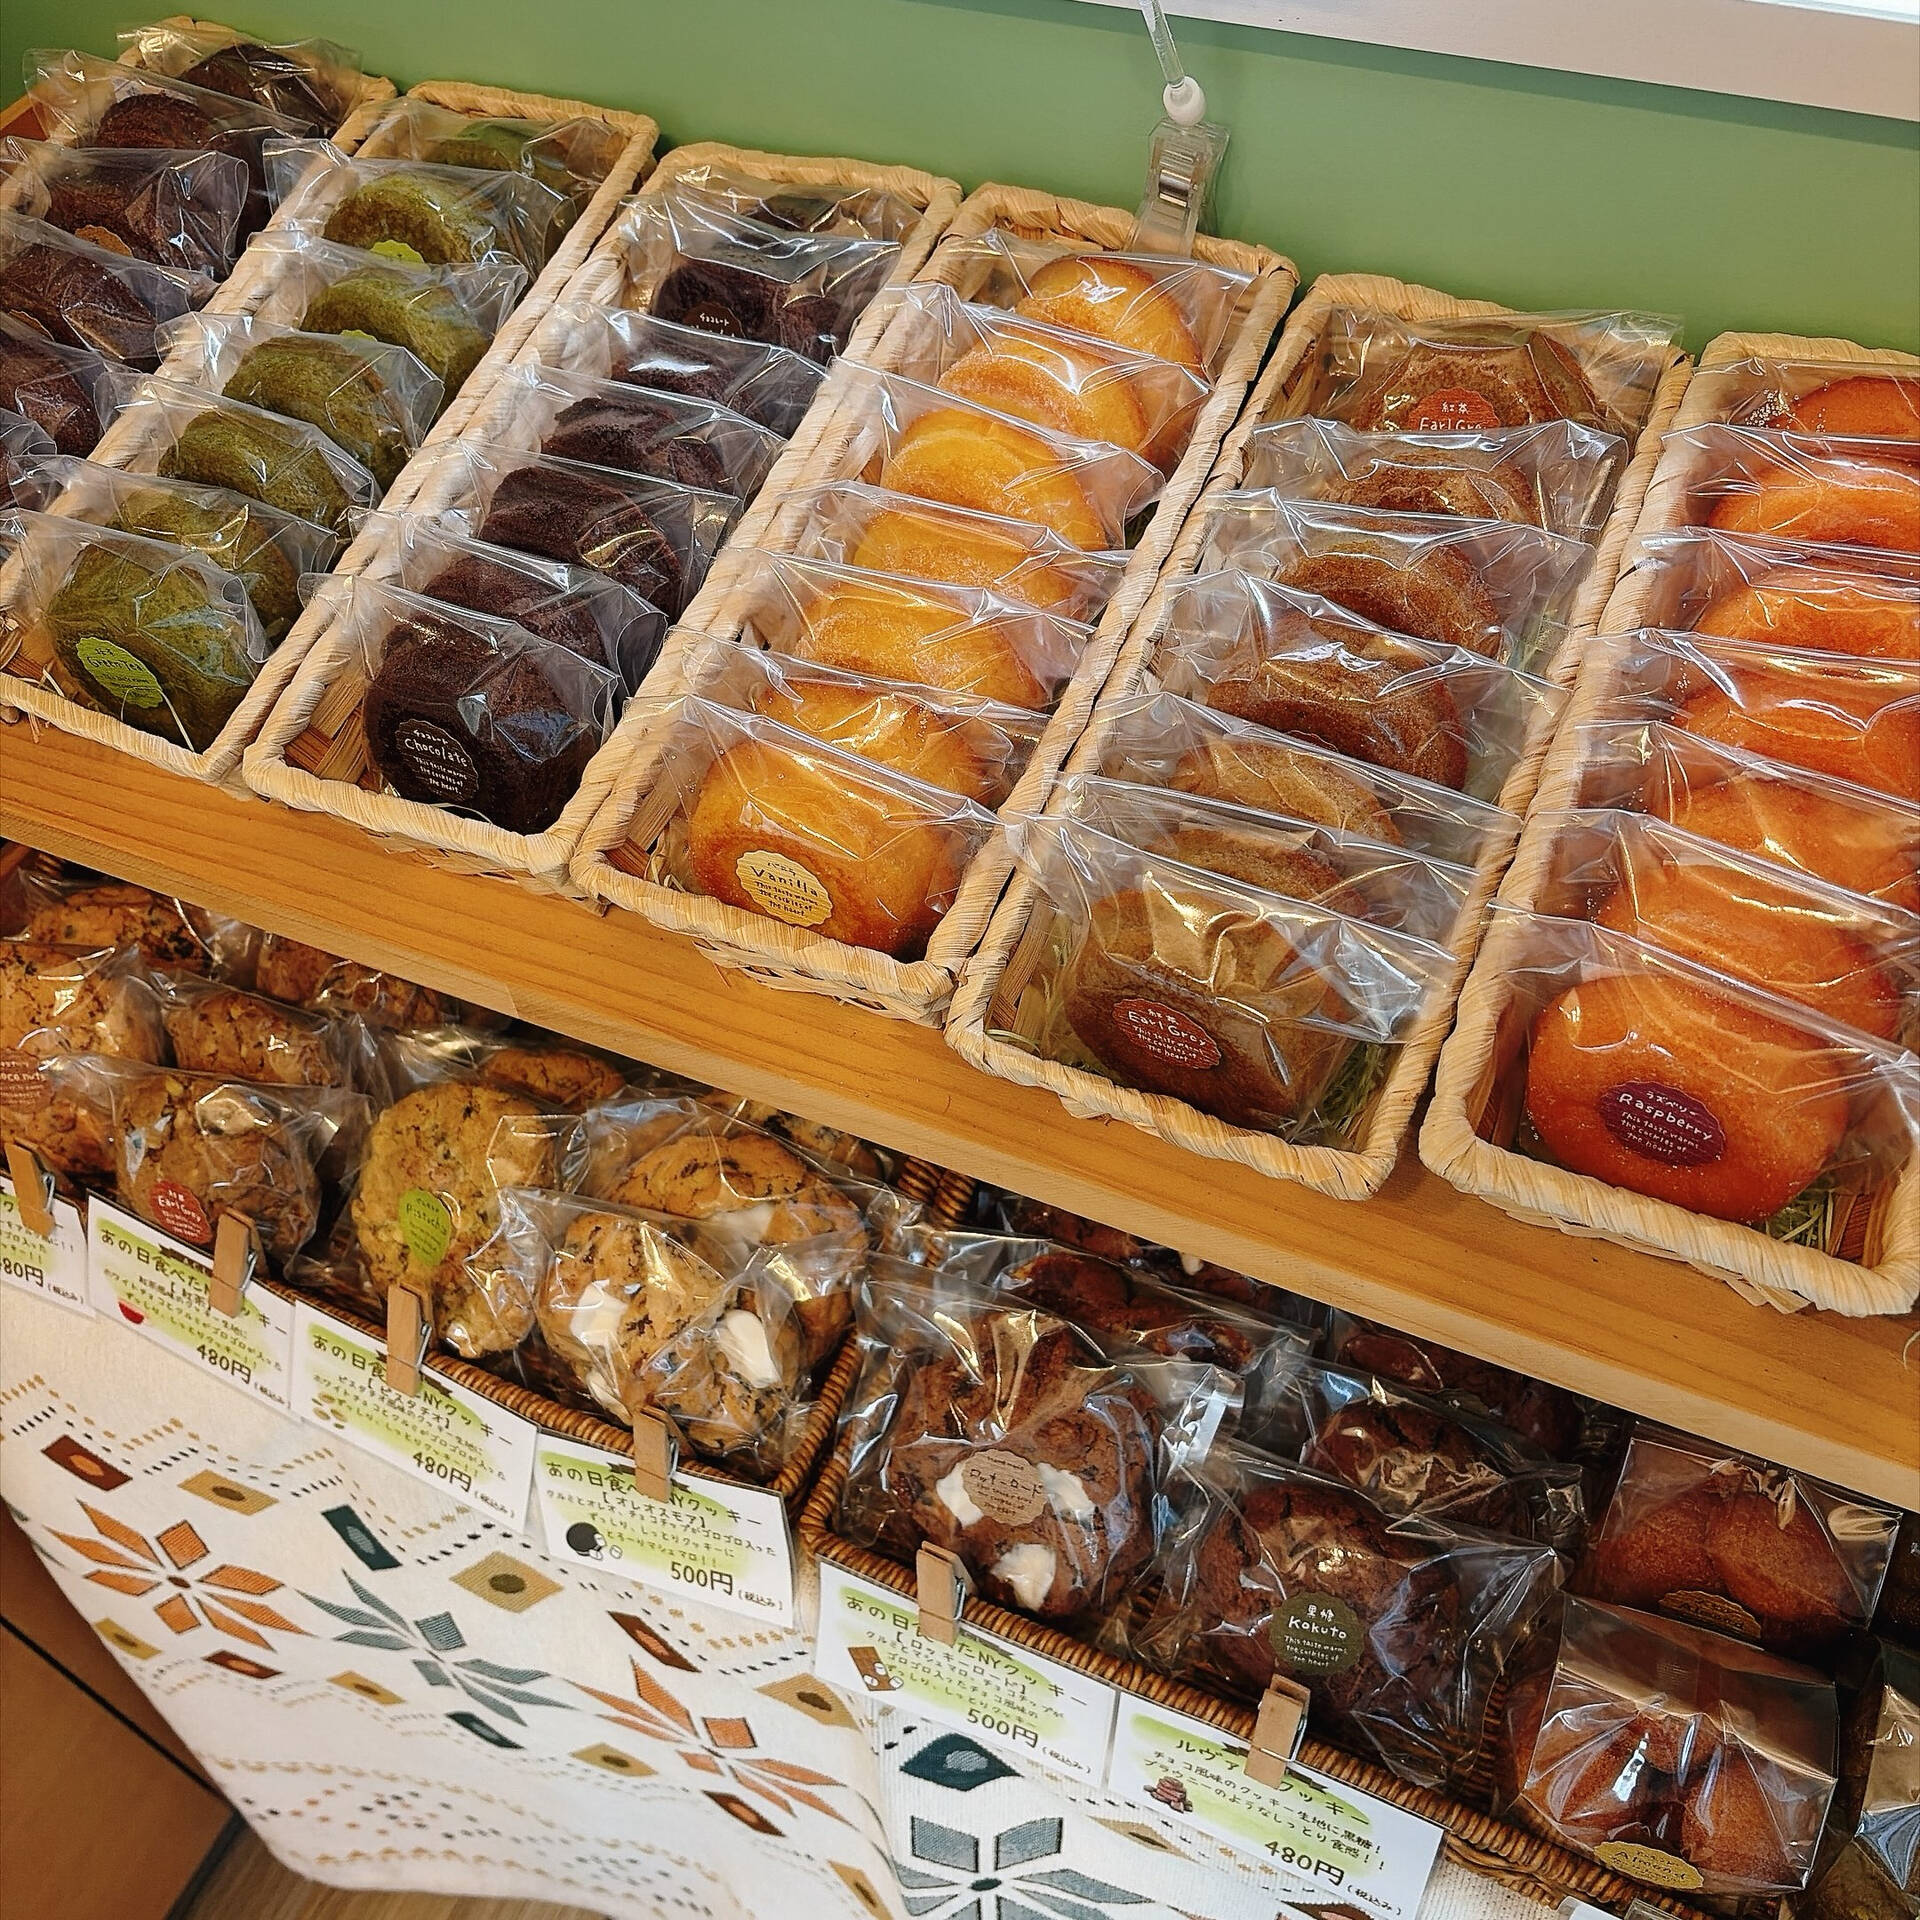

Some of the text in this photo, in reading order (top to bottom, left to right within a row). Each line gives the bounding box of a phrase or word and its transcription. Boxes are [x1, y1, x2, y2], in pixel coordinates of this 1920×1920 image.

[1420, 417, 1486, 430] Earl Gre
[1441, 402, 1468, 414] 紅茶
[405, 738, 467, 767] Chocolate
[414, 729, 448, 745] チョコレート
[750, 865, 818, 897] Vanilla
[1128, 1011, 1206, 1046] Earl Grey
[1619, 1093, 1713, 1141] Raspberry
[1646, 1090, 1696, 1116] ラズベリー
[158, 1195, 180, 1209] Earl
[0, 1257, 43, 1287] 80円
[100, 1228, 287, 1335] あの日食べたッキー
[196, 1344, 252, 1385] 480円
[313, 1335, 513, 1446] あの日食NYクッキー
[412, 1452, 472, 1493] 480円
[670, 1561, 733, 1596] 500円
[1288, 1615, 1347, 1639] Kokuto
[846, 1595, 1087, 1706] あの日たNYクッキー
[966, 1709, 1038, 1748] 500円
[1176, 1739, 1370, 1825] ルヴァクッキー
[1264, 1840, 1345, 1886] 480円
